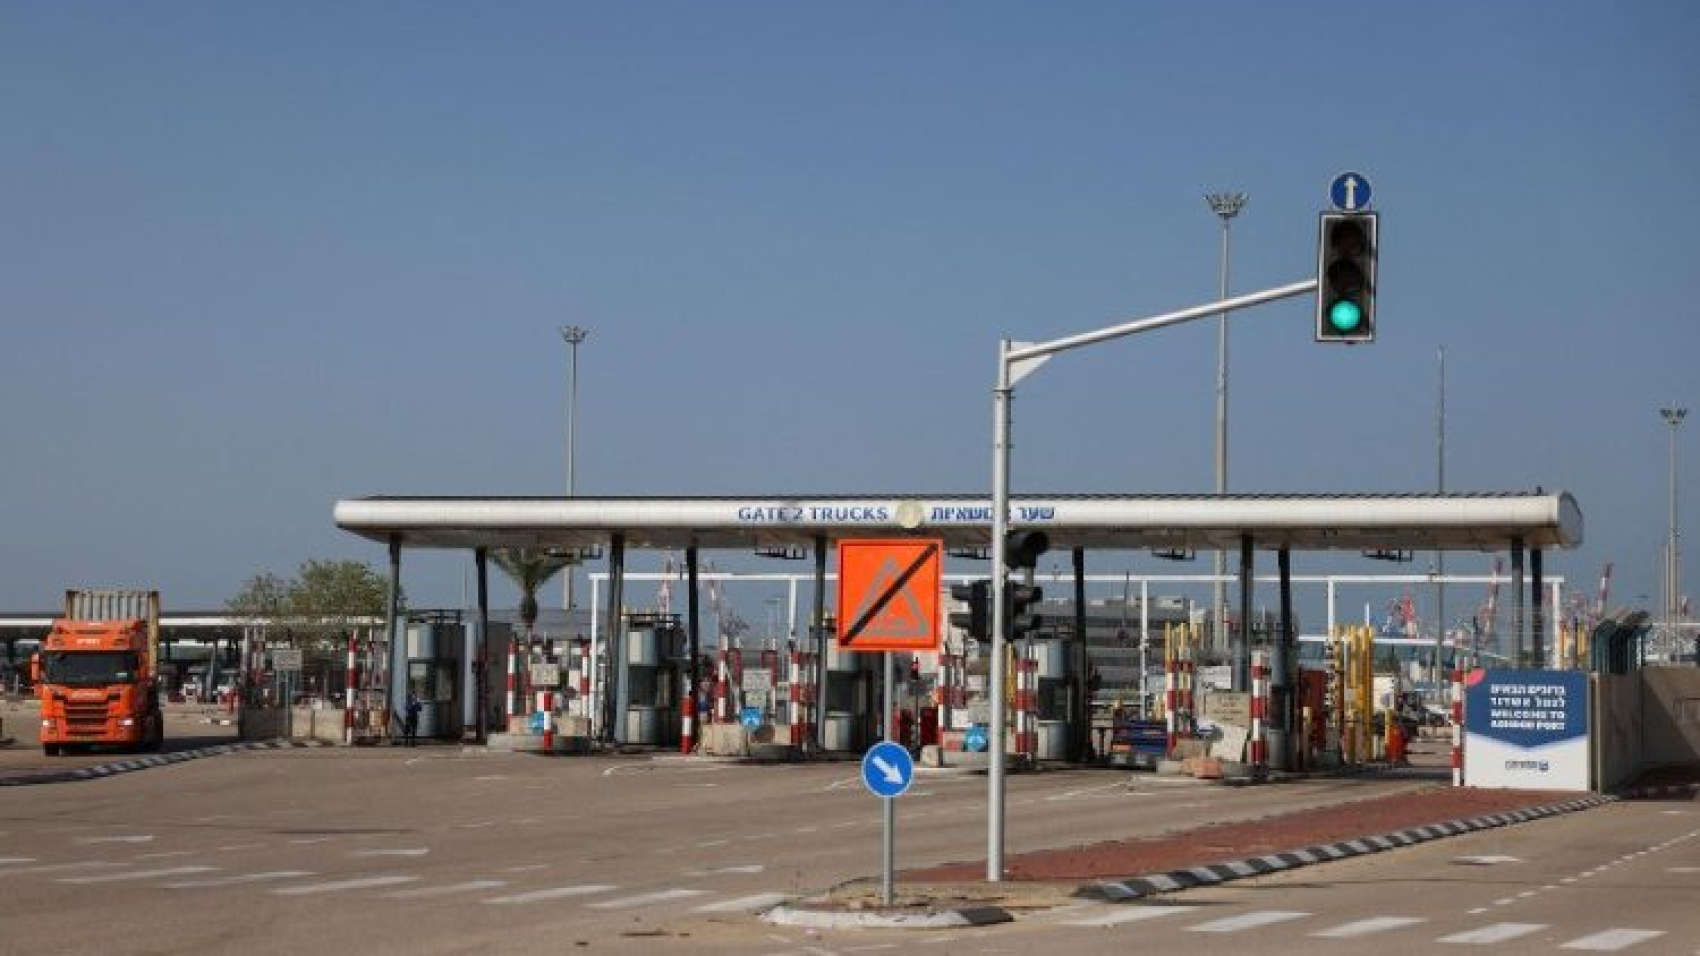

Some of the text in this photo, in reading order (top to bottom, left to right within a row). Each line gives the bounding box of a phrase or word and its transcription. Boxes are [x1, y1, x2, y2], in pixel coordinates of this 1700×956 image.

[738, 506, 888, 521] GATE 2 TRUCKS
[1017, 506, 1055, 521] שער
[1491, 709, 1564, 719] WELCOME TO
